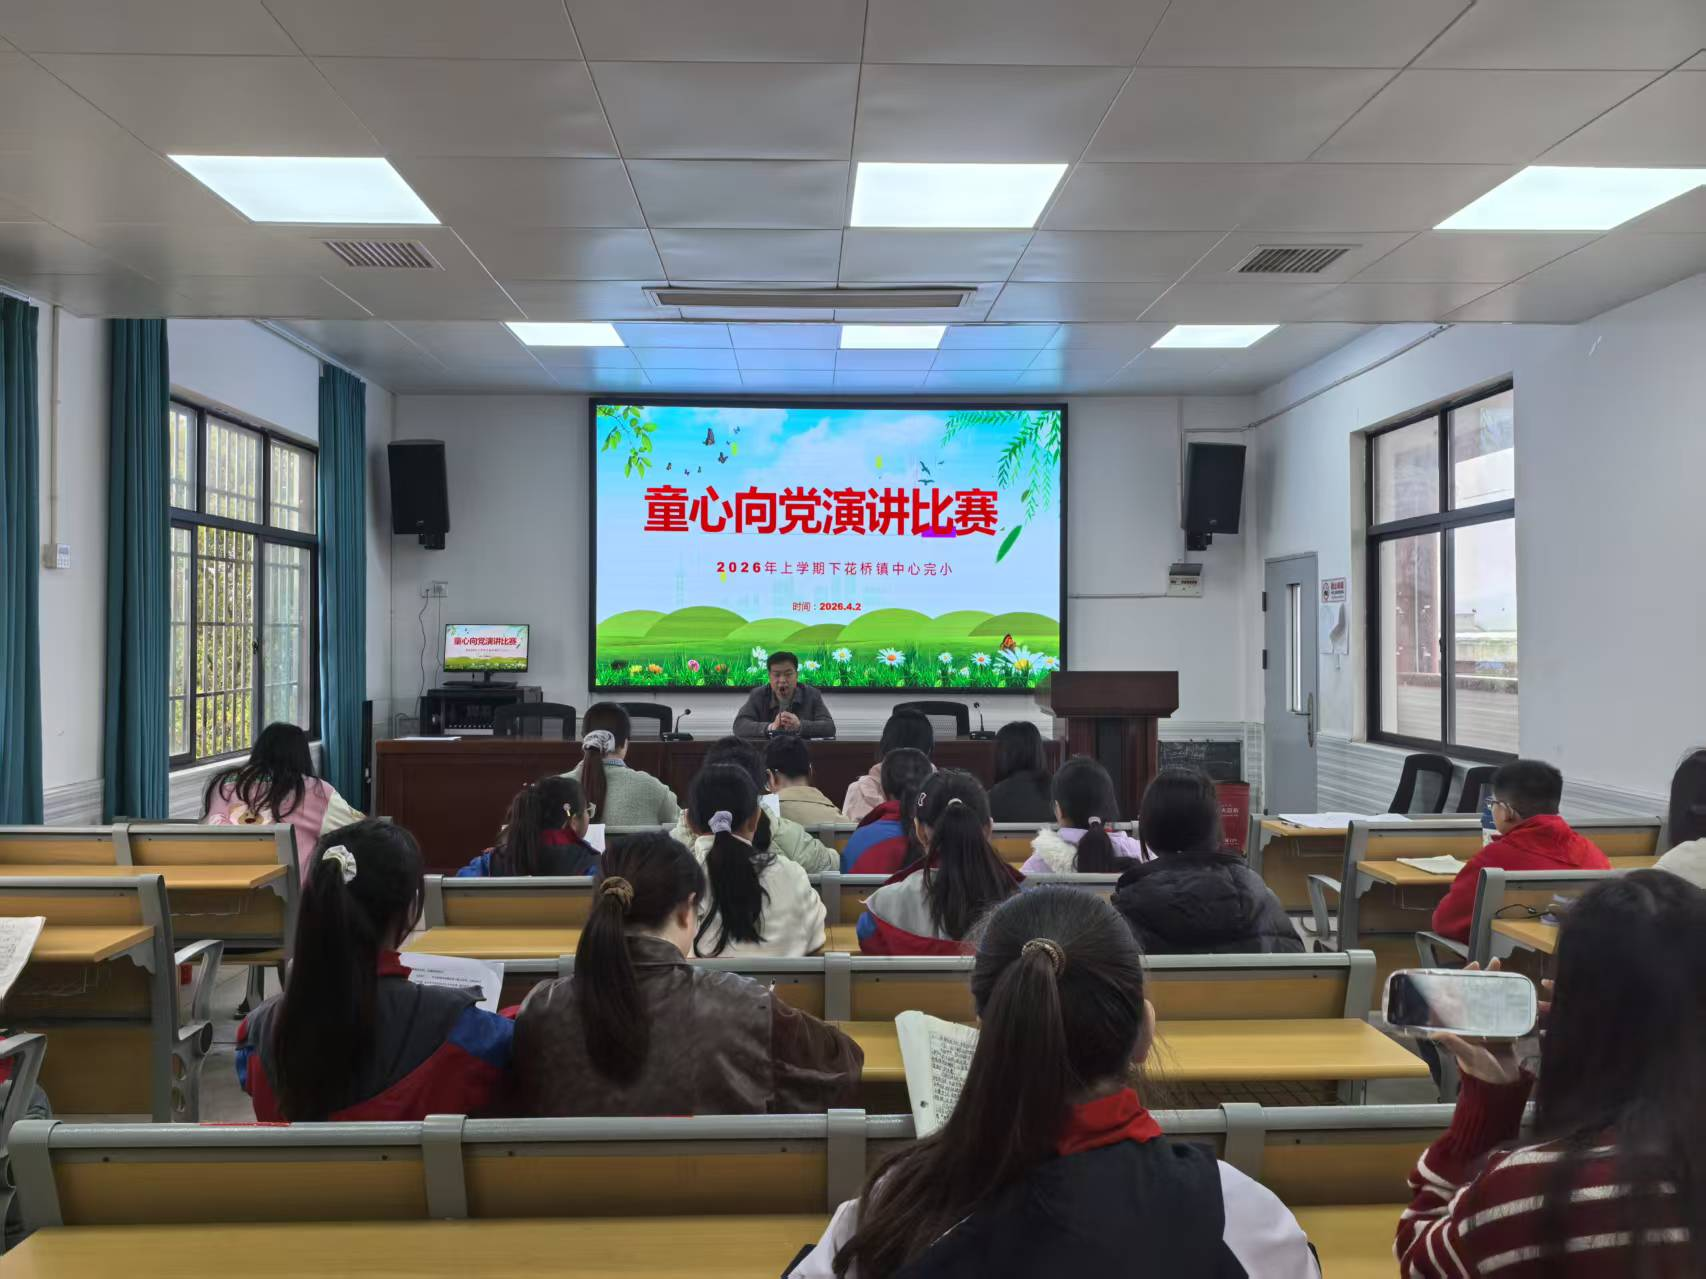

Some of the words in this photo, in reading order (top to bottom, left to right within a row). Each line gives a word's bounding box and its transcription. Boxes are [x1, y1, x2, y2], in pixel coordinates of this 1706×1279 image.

[644, 484, 998, 536] 童心向党演讲比赛
[716, 560, 953, 576] 2026年上学期下花桥镇中心完小
